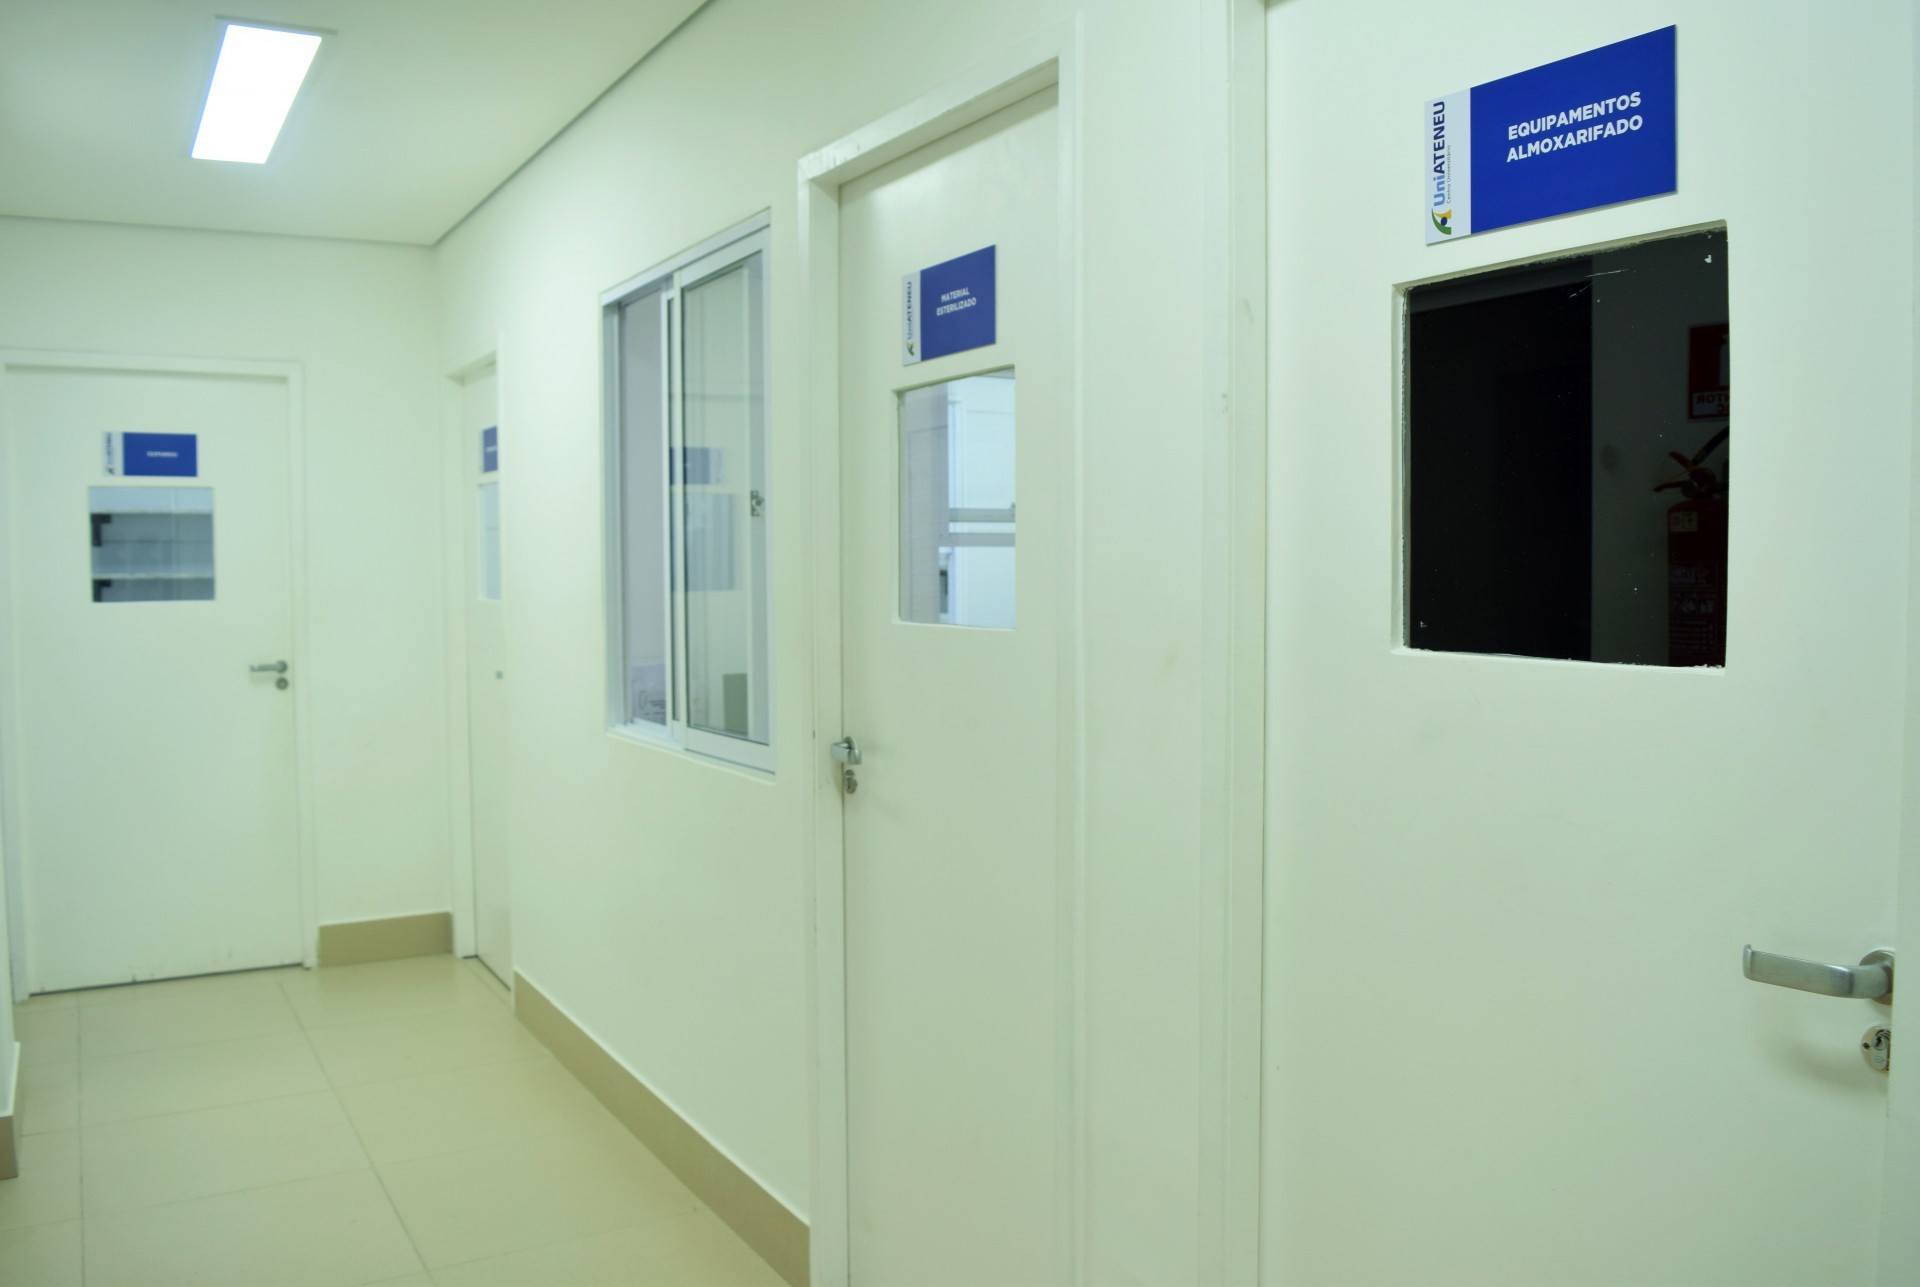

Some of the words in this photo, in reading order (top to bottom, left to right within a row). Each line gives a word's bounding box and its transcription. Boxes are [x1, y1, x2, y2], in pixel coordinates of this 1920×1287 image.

[1506, 114, 1644, 163] ALMOXARIFADO
[1507, 91, 1642, 141] EQUIPAMENTOS
[1432, 101, 1446, 207] UniATENEU
[936, 297, 977, 317] ESTERILIZADO
[941, 287, 970, 303] MATERIAL
